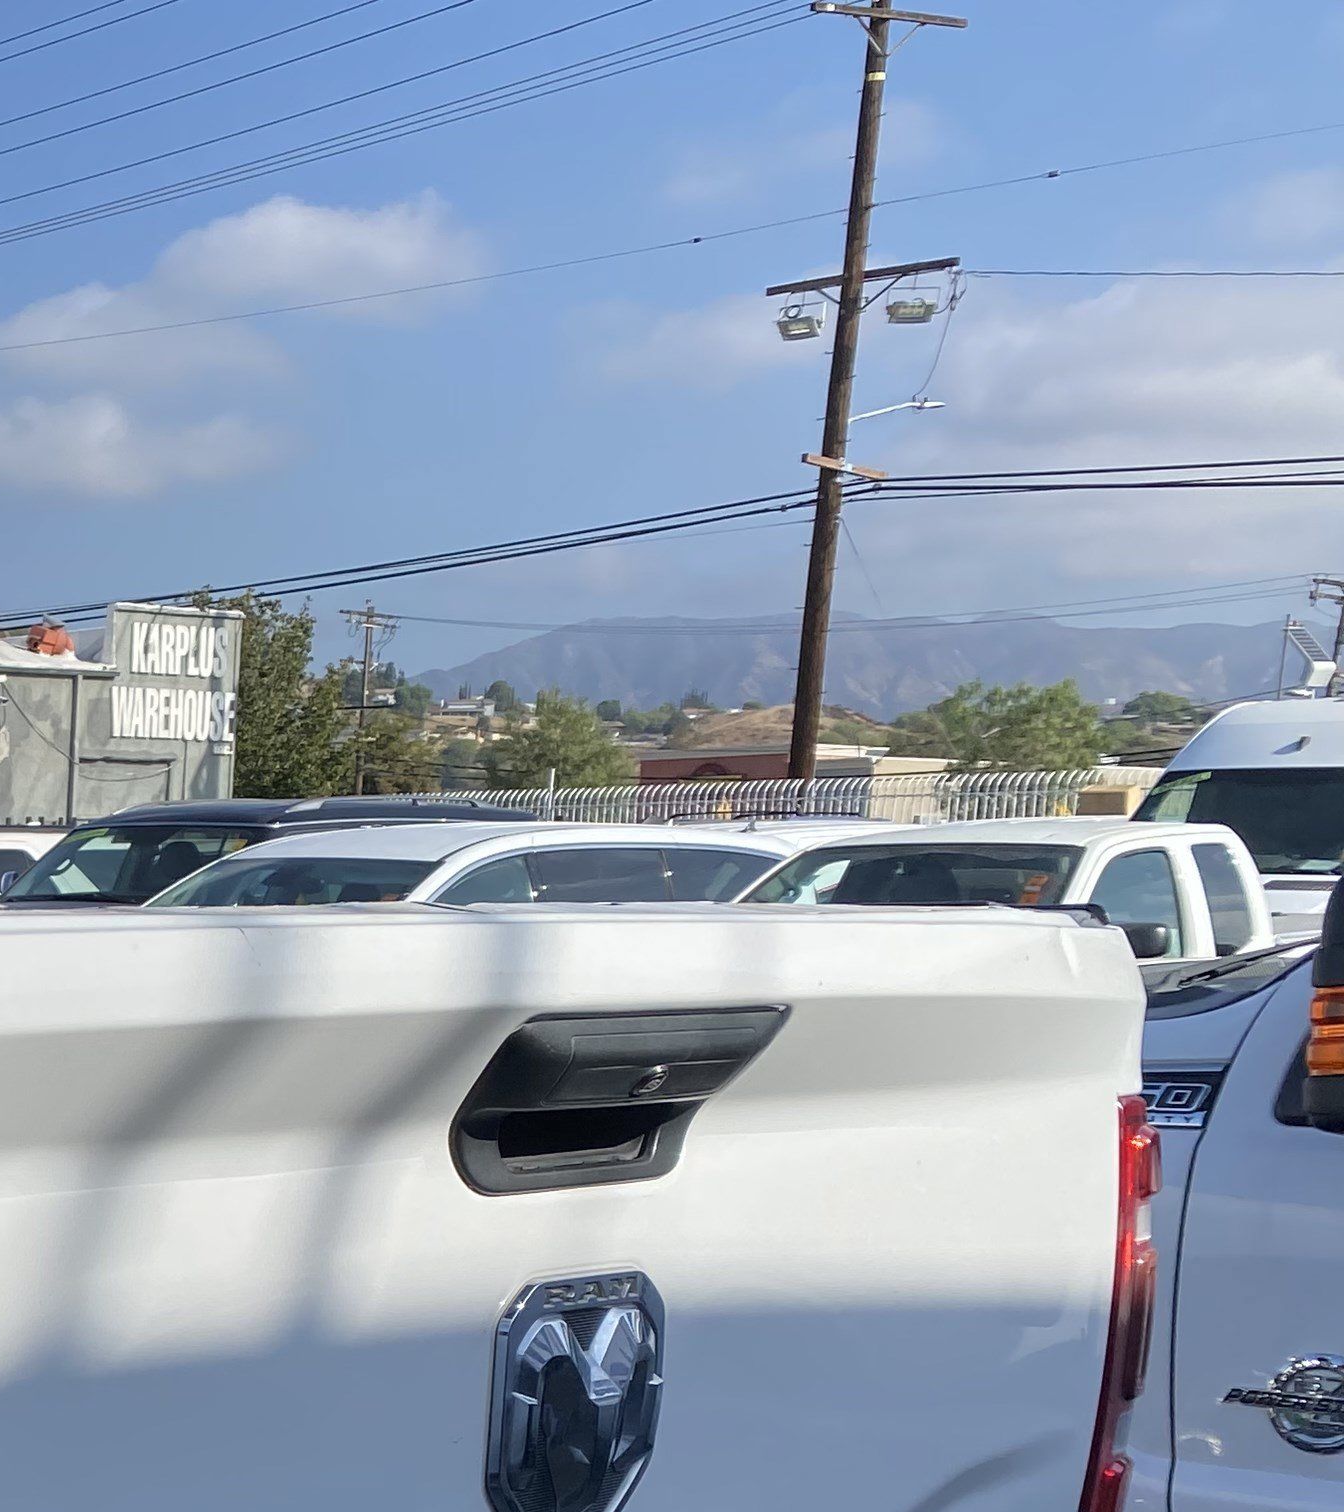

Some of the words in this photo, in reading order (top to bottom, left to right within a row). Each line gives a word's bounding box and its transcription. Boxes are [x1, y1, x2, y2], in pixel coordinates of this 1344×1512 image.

[131, 622, 229, 678] KARPLUS
[112, 686, 236, 742] WAREHOUSE
[543, 1276, 640, 1309] RAM
